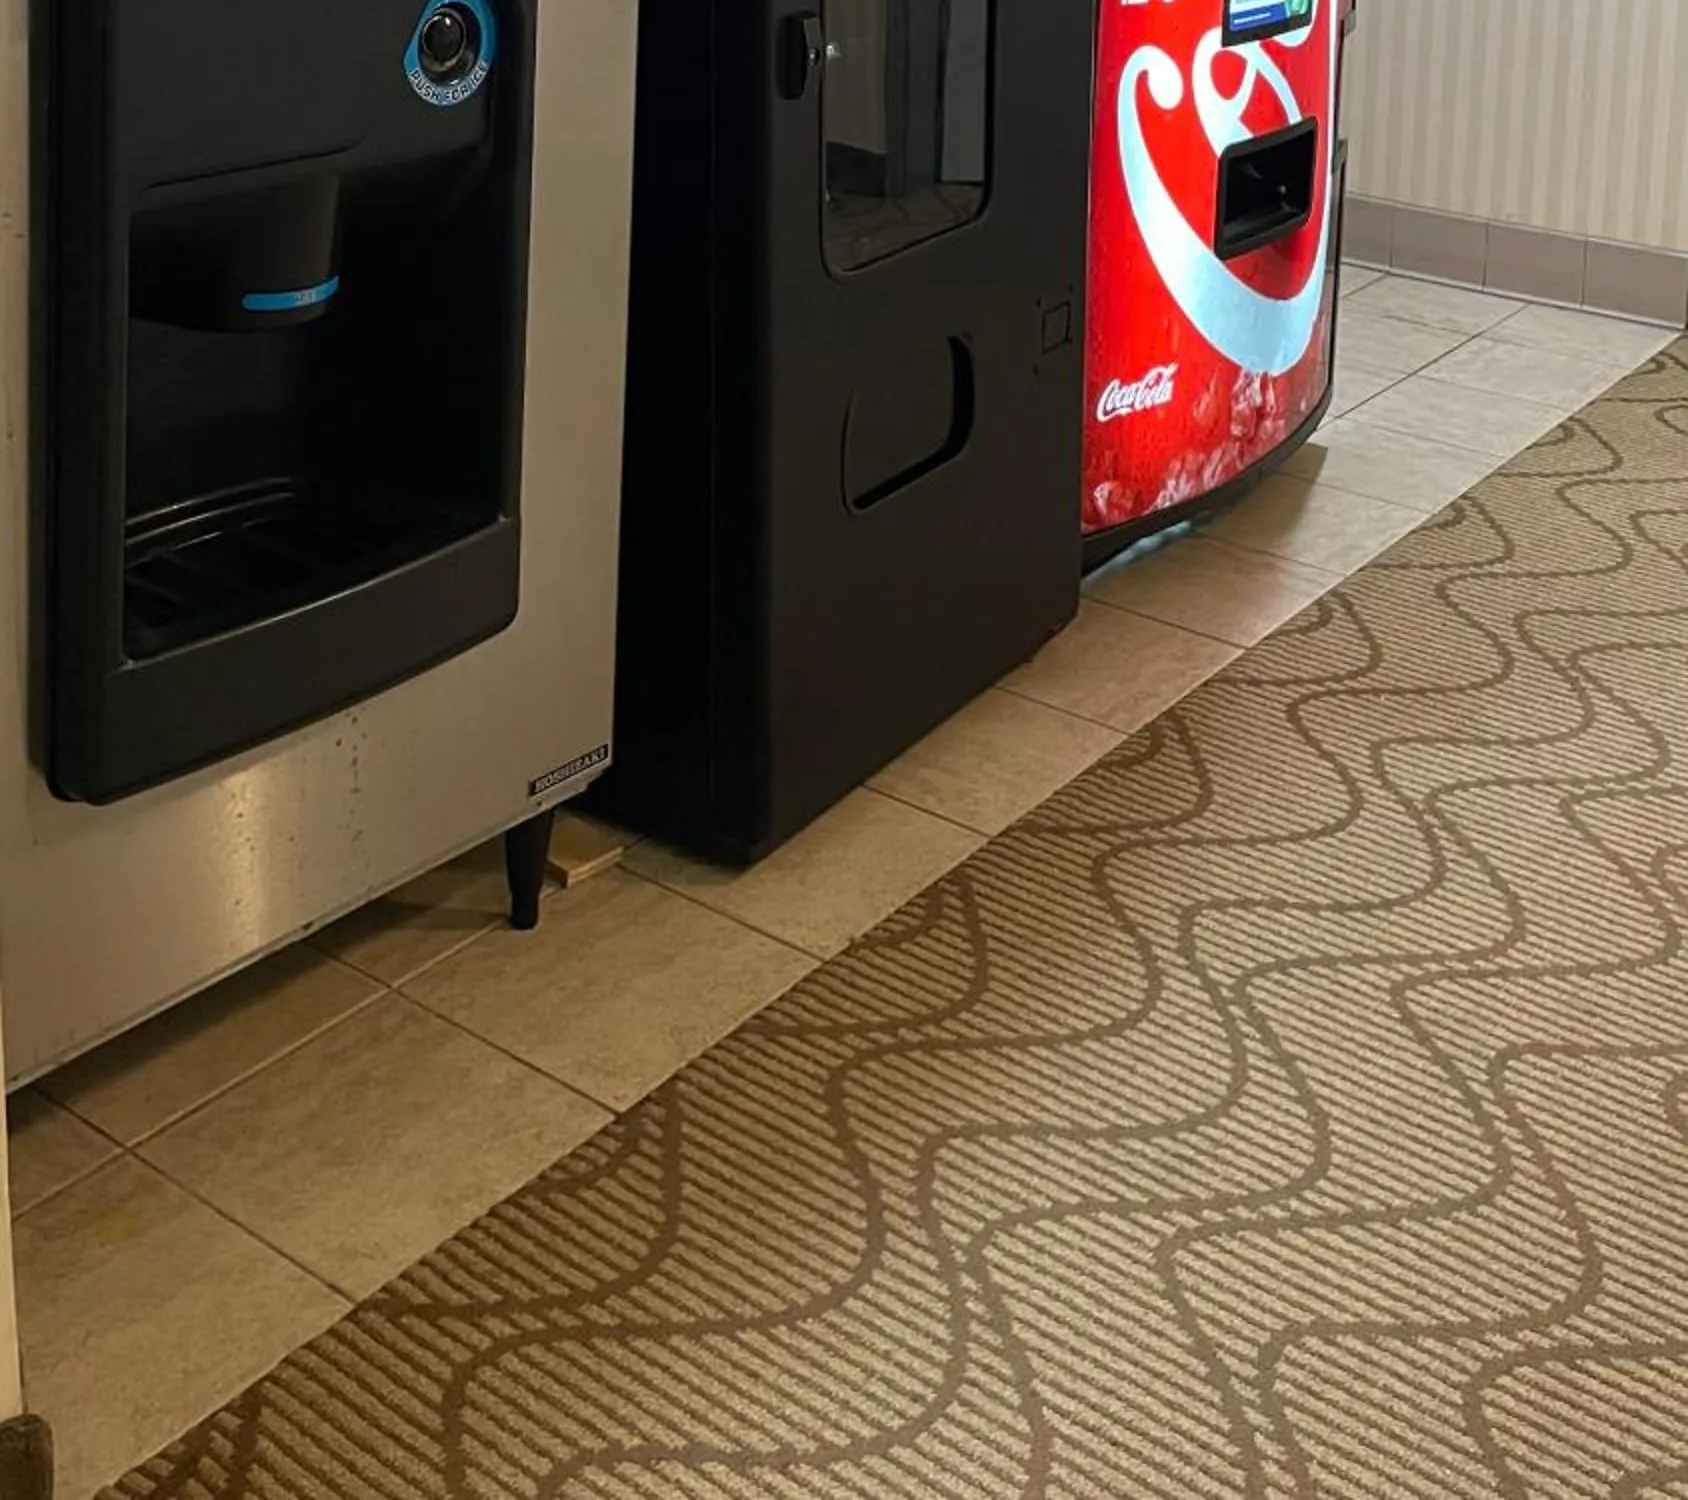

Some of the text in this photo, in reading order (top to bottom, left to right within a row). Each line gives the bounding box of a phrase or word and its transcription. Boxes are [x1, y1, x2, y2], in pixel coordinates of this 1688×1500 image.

[408, 67, 440, 100] PUSH
[444, 84, 471, 100] FOR
[1097, 363, 1178, 422] Coca-Cola
